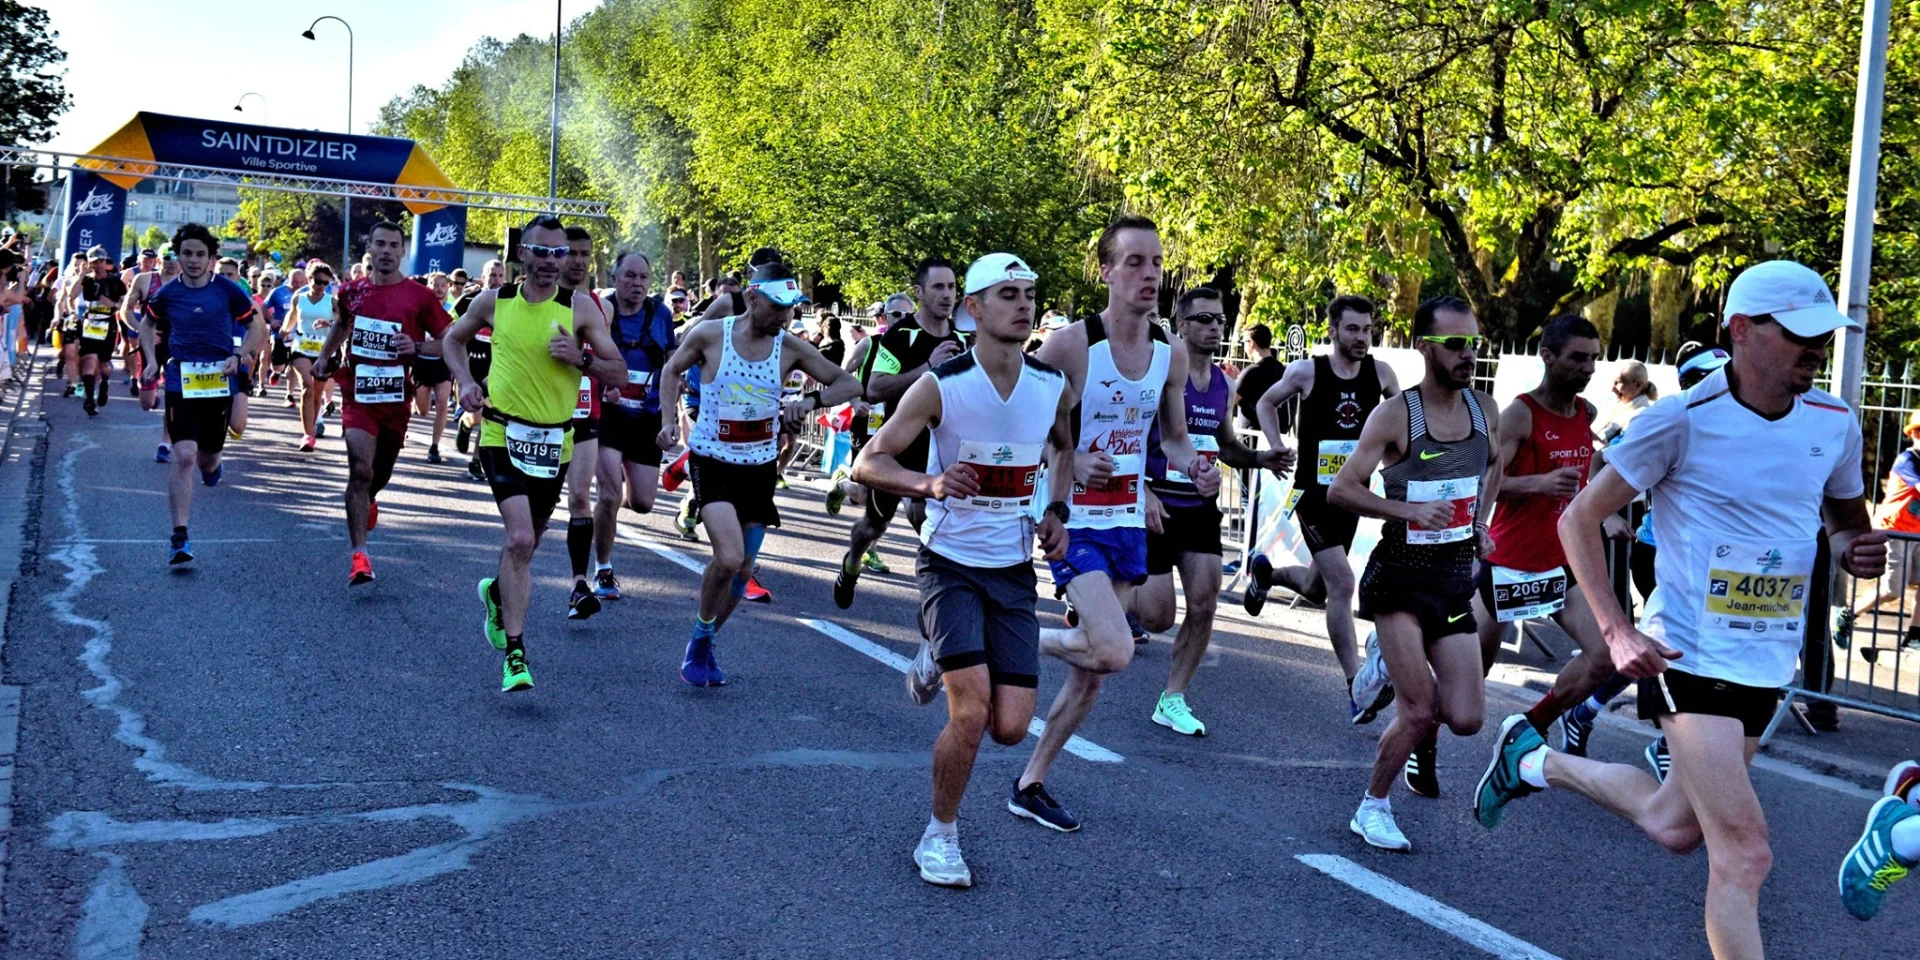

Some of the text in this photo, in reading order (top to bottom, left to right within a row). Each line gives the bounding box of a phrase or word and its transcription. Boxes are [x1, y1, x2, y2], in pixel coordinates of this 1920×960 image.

[241, 156, 317, 172] Ville Sportive
[362, 331, 388, 343] 2014
[363, 340, 386, 350] David
[366, 377, 393, 387] 2014
[1192, 405, 1216, 415] Tarkett
[515, 441, 548, 456] 2019
[1549, 449, 1573, 460] SPORT
[984, 467, 1015, 482] 211
[1511, 580, 1549, 597] 2067
[1735, 575, 1790, 598] 4037
[1726, 599, 1790, 612] Jean-michel
